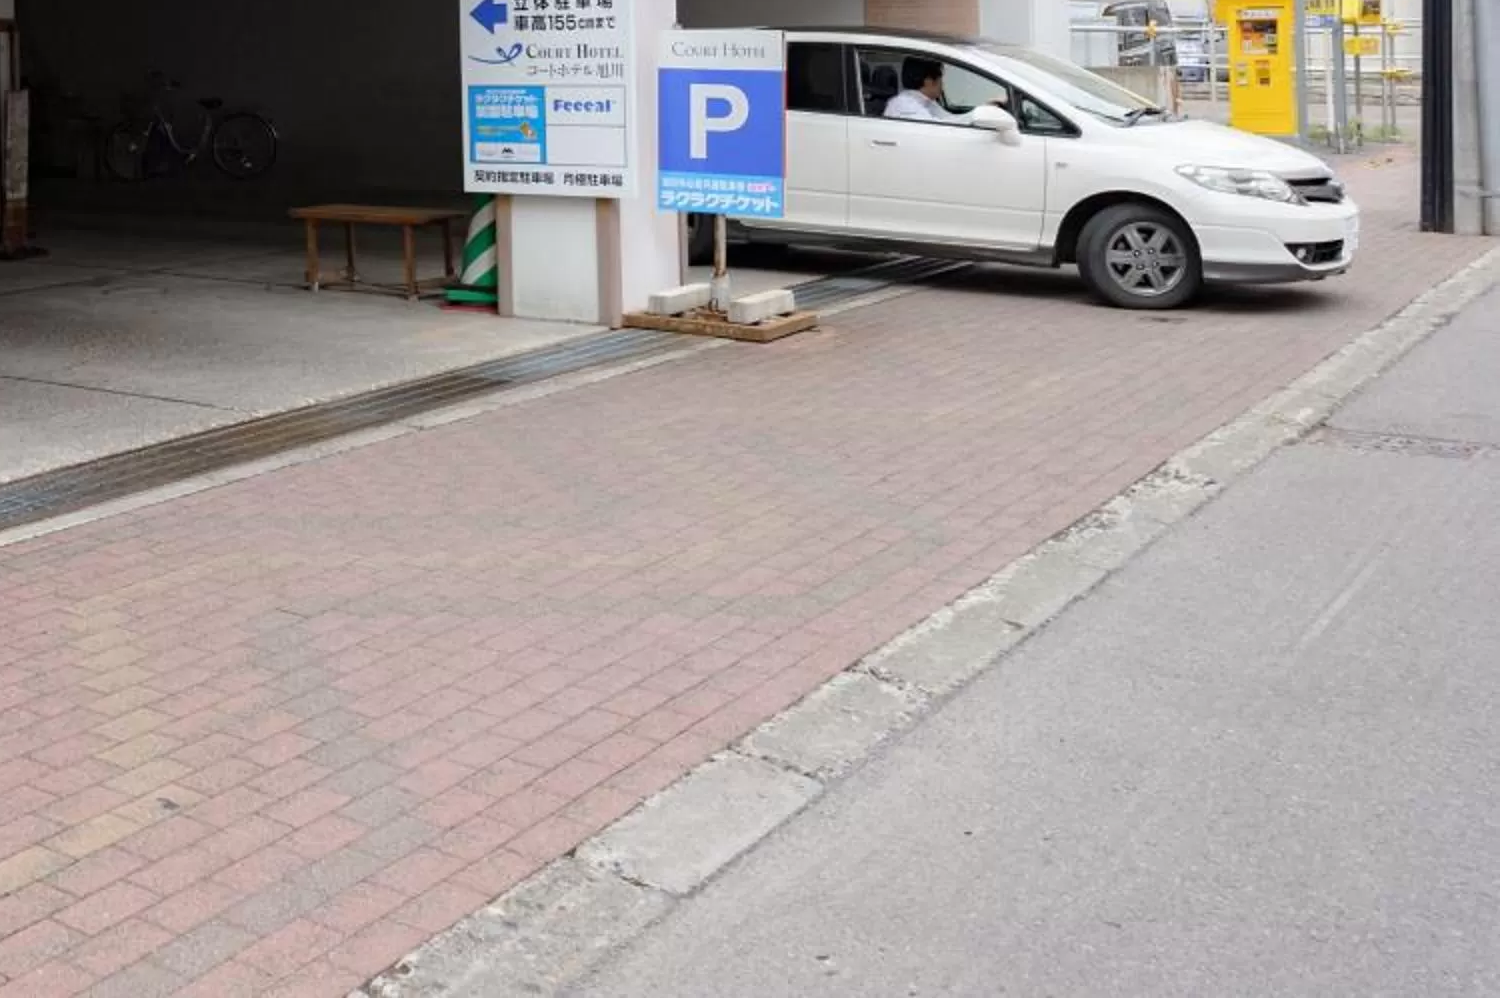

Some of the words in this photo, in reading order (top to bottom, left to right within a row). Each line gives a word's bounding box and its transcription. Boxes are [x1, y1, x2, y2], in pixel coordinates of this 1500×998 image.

[689, 83, 749, 159] P
[661, 190, 779, 212] ラクラクチケット
